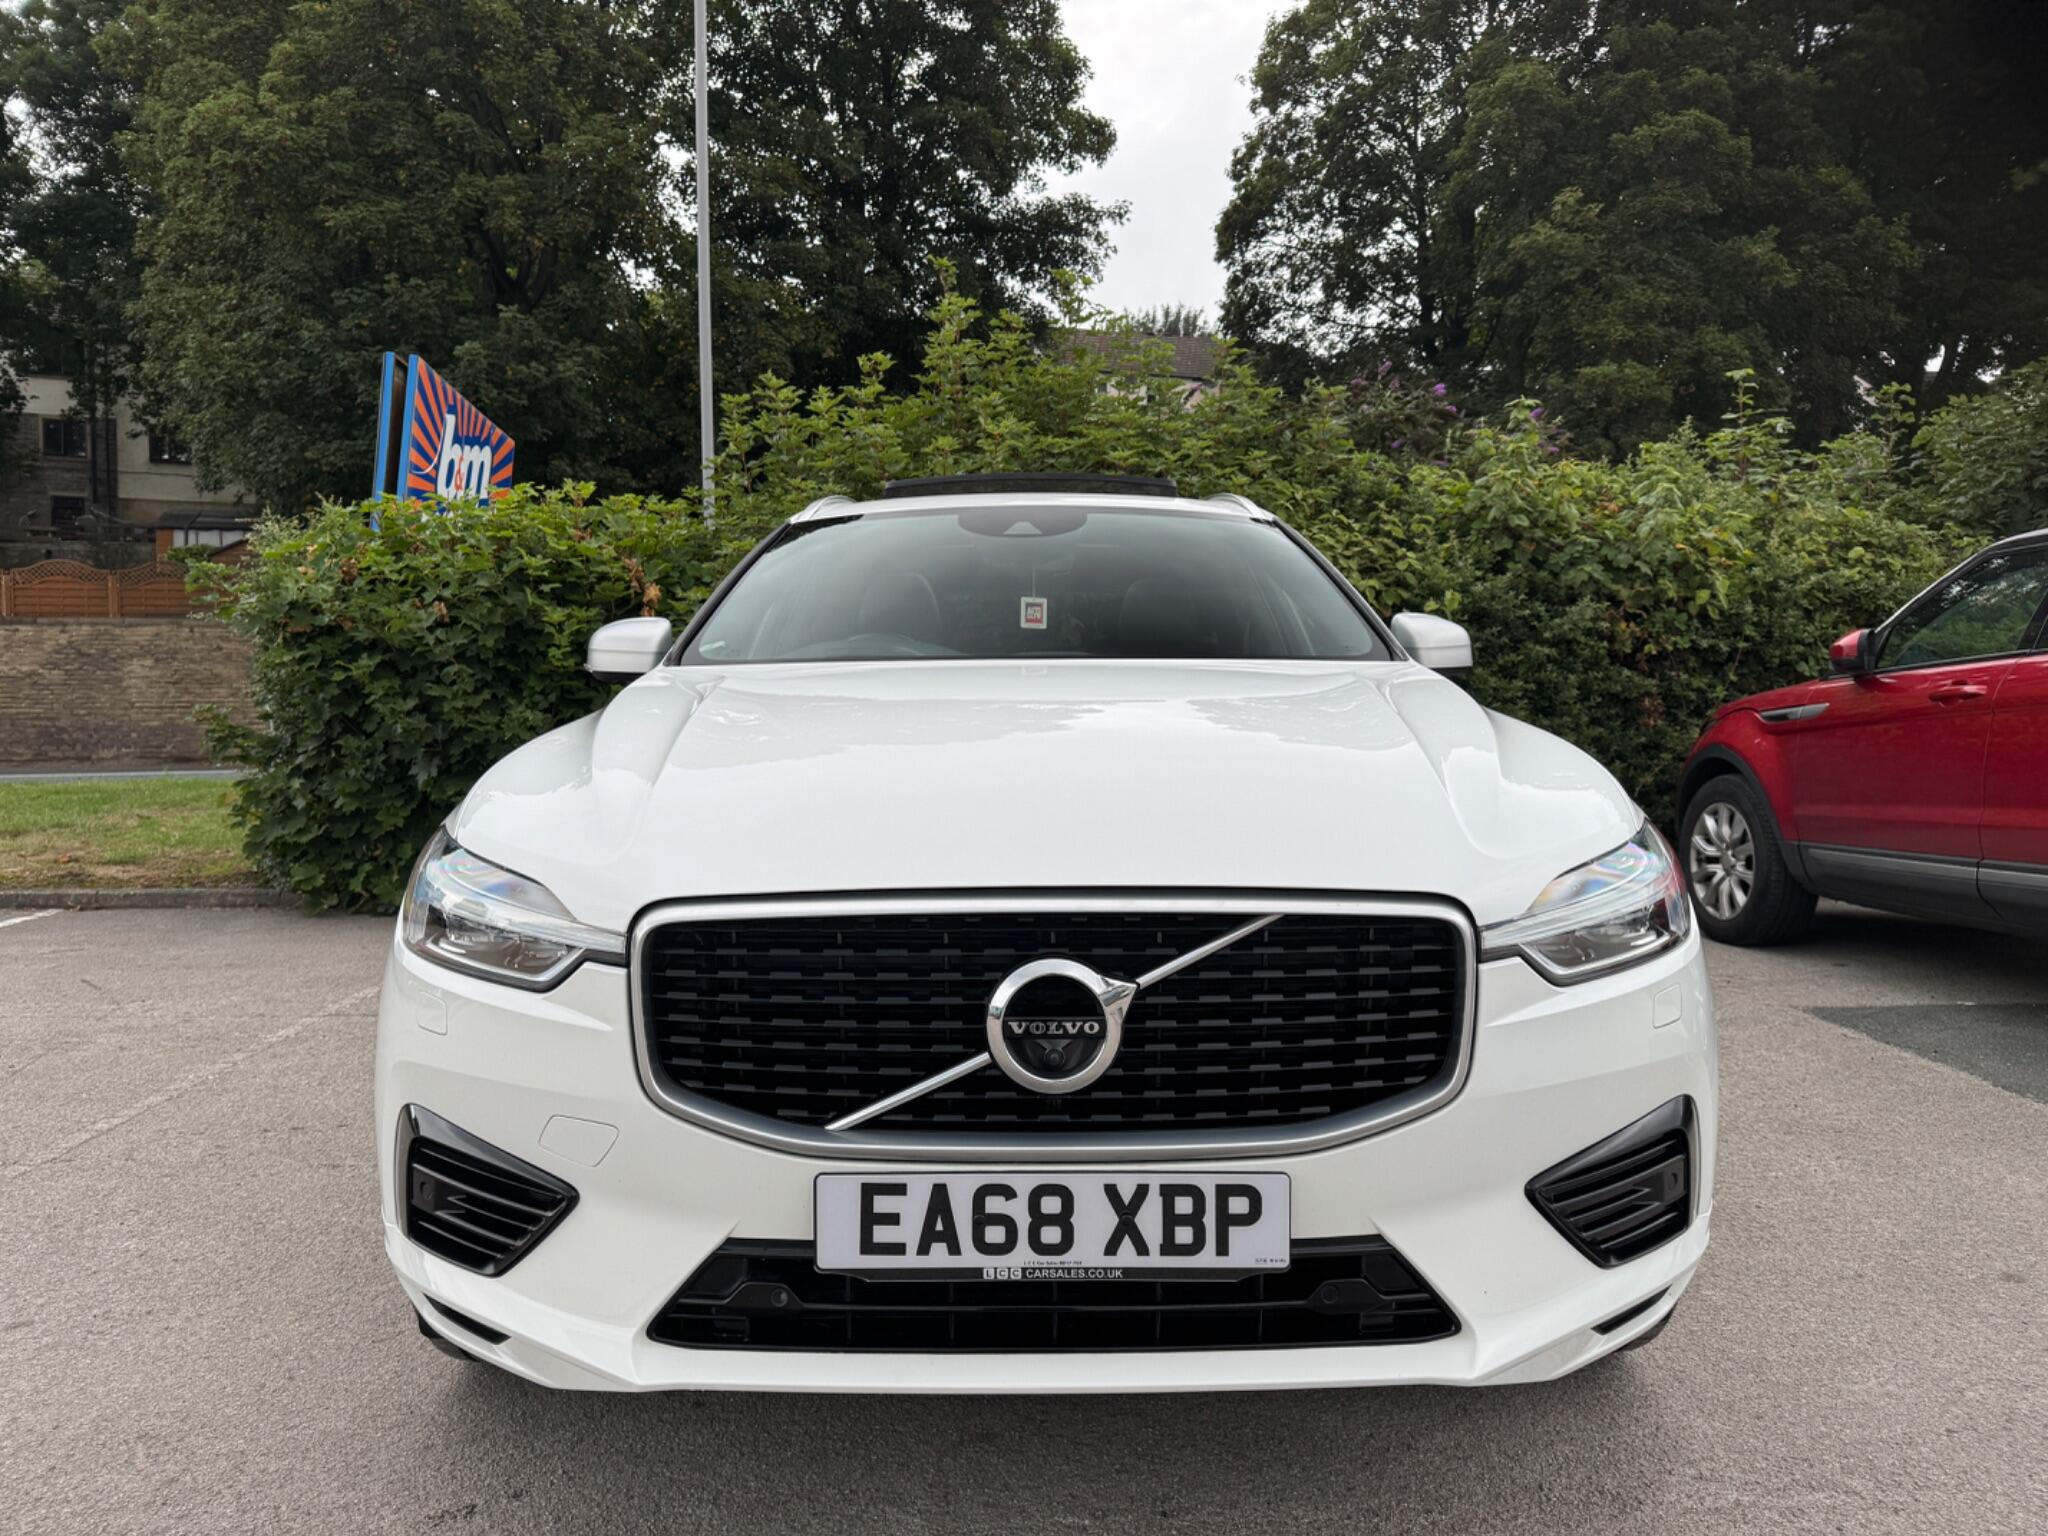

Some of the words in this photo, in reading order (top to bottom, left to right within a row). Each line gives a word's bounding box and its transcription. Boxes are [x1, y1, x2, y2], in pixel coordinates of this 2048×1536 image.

[1008, 1021, 1100, 1034] VOLVO
[859, 1182, 1075, 1257] EA68
[1103, 1183, 1263, 1257] XBP
[1026, 1268, 1124, 1279] CARSALES.CO.UK
